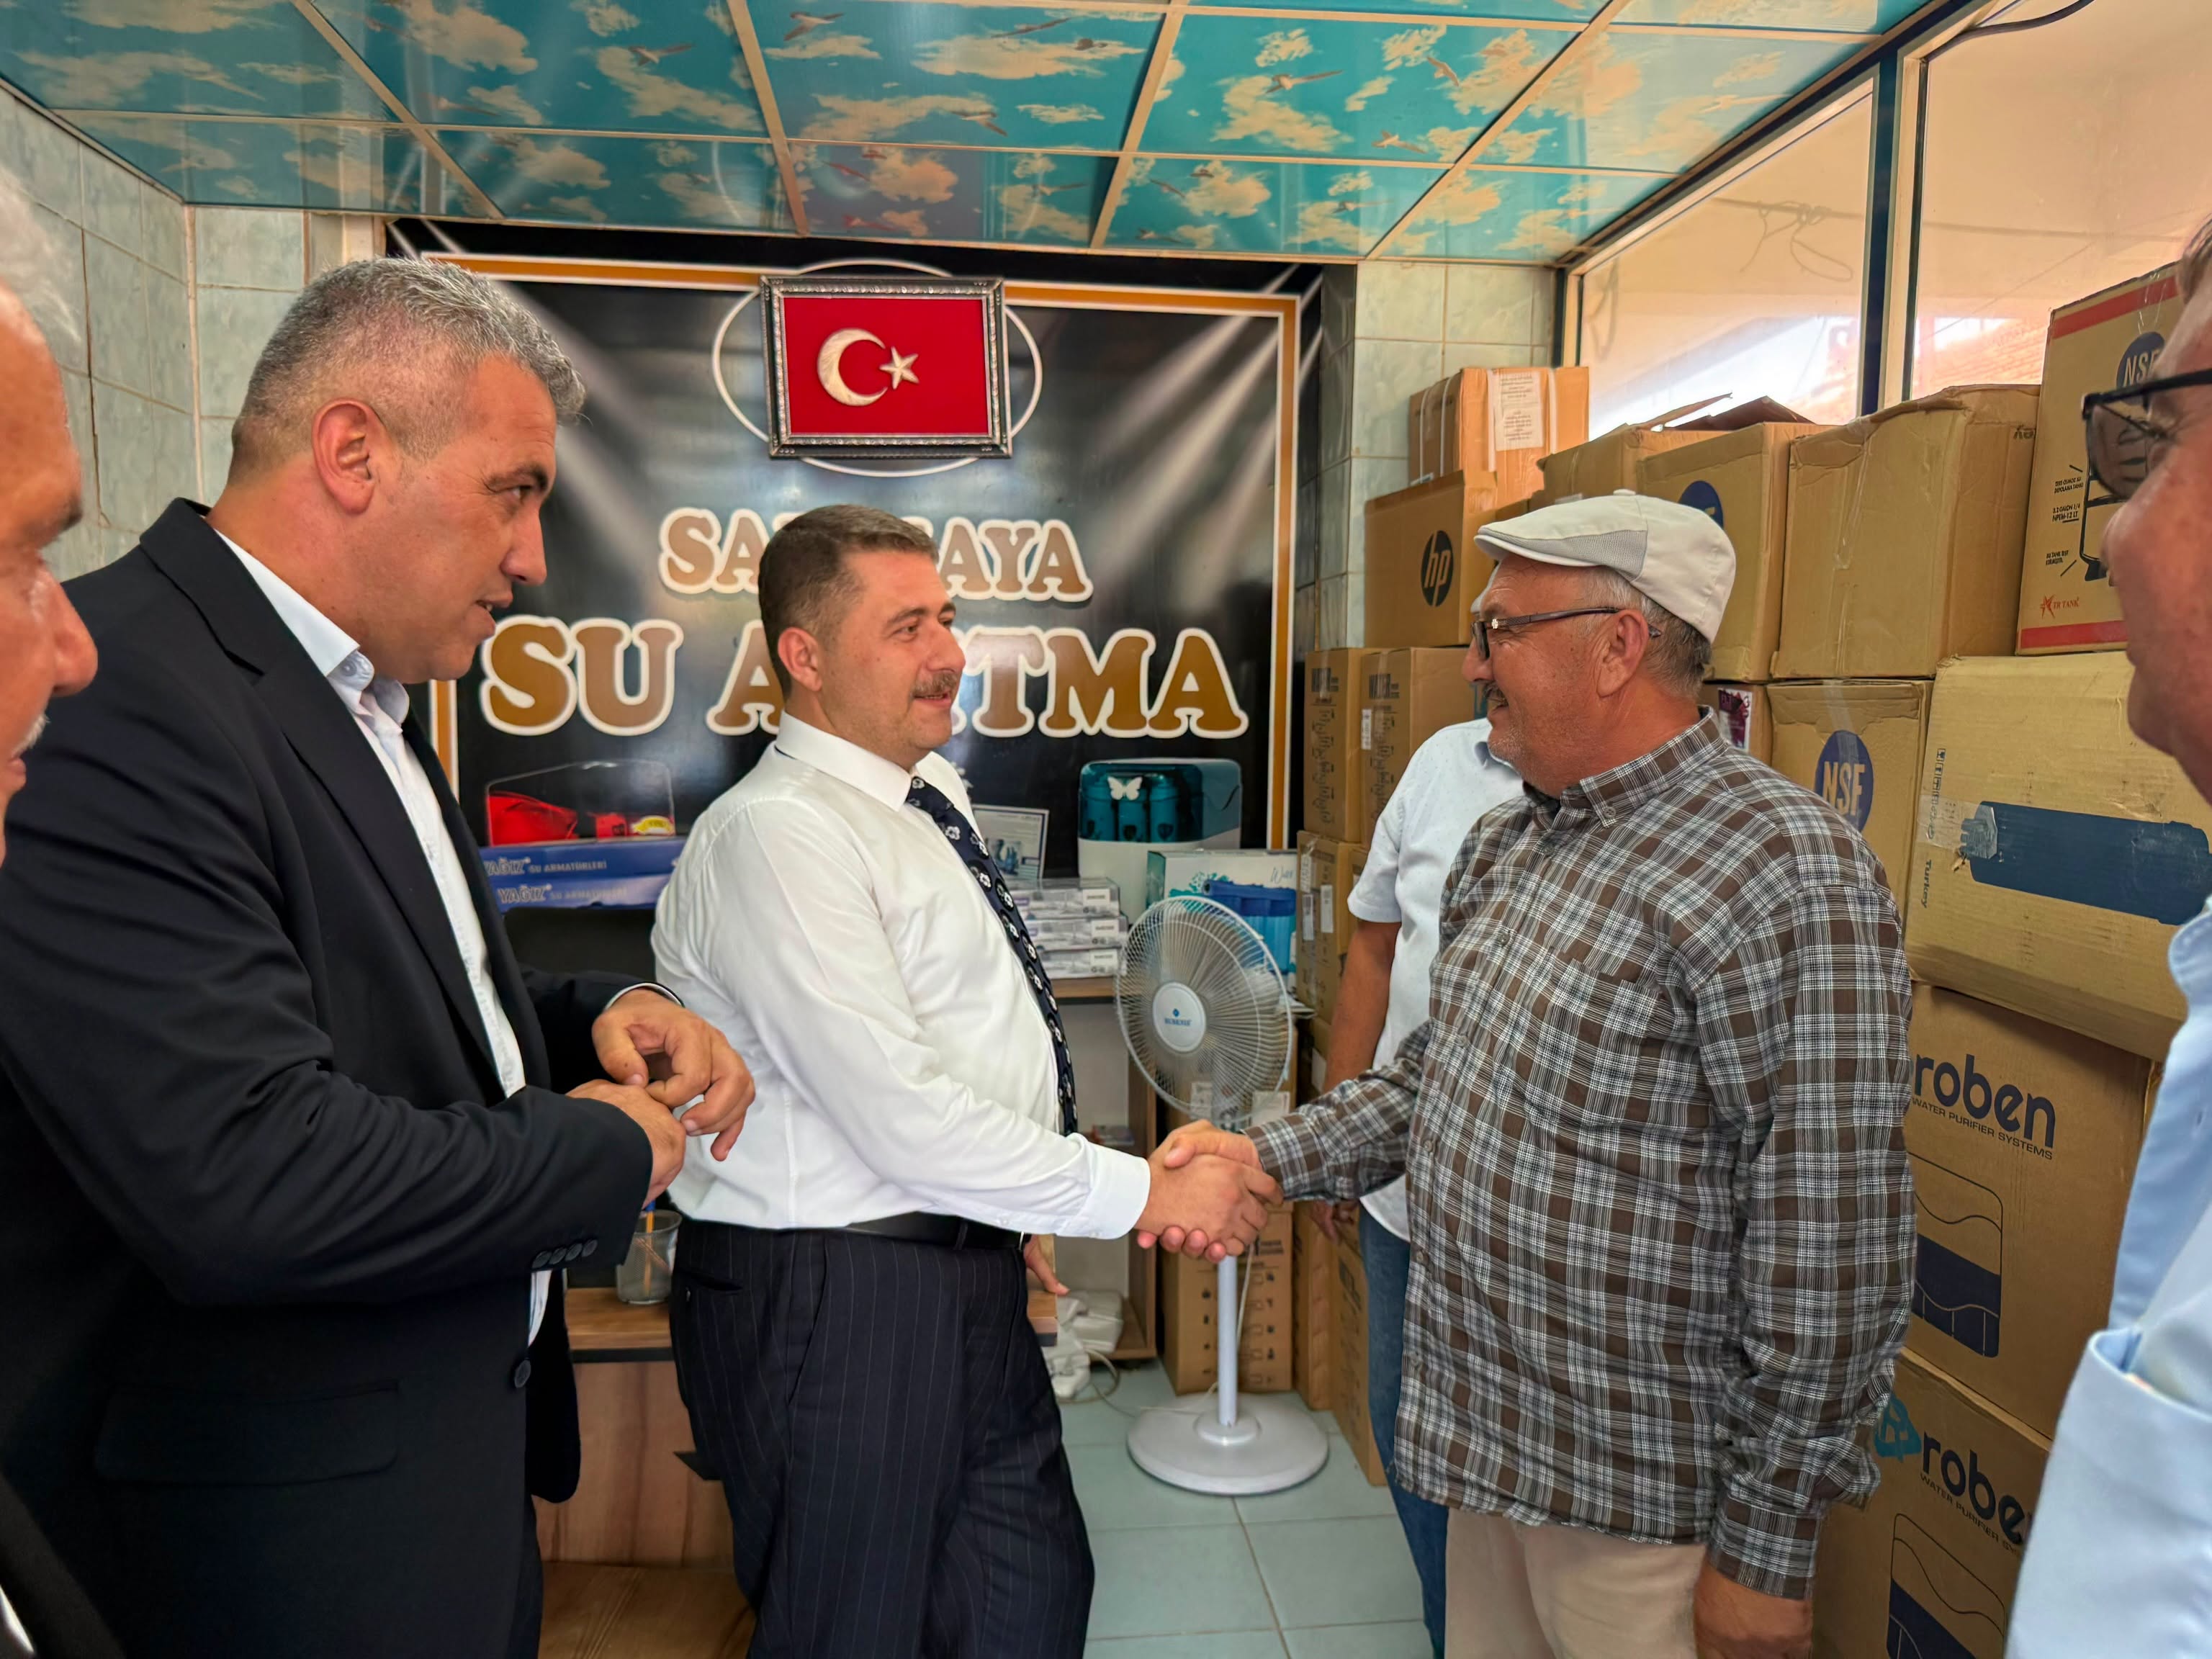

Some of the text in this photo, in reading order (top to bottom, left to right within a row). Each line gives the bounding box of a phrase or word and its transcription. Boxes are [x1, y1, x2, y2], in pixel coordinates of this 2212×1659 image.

[1424, 531, 1451, 607] hp
[480, 614, 1249, 739] SU ATMA
[1822, 761, 1866, 817] NSF
[1921, 859, 1932, 909] Turkey
[1912, 1097, 2053, 1161] WATER PURIFIER SYSTEMS
[1915, 1053, 2056, 1148] roben
[1920, 1473, 1954, 1506] WATER
[1923, 1431, 2032, 1545] robe
